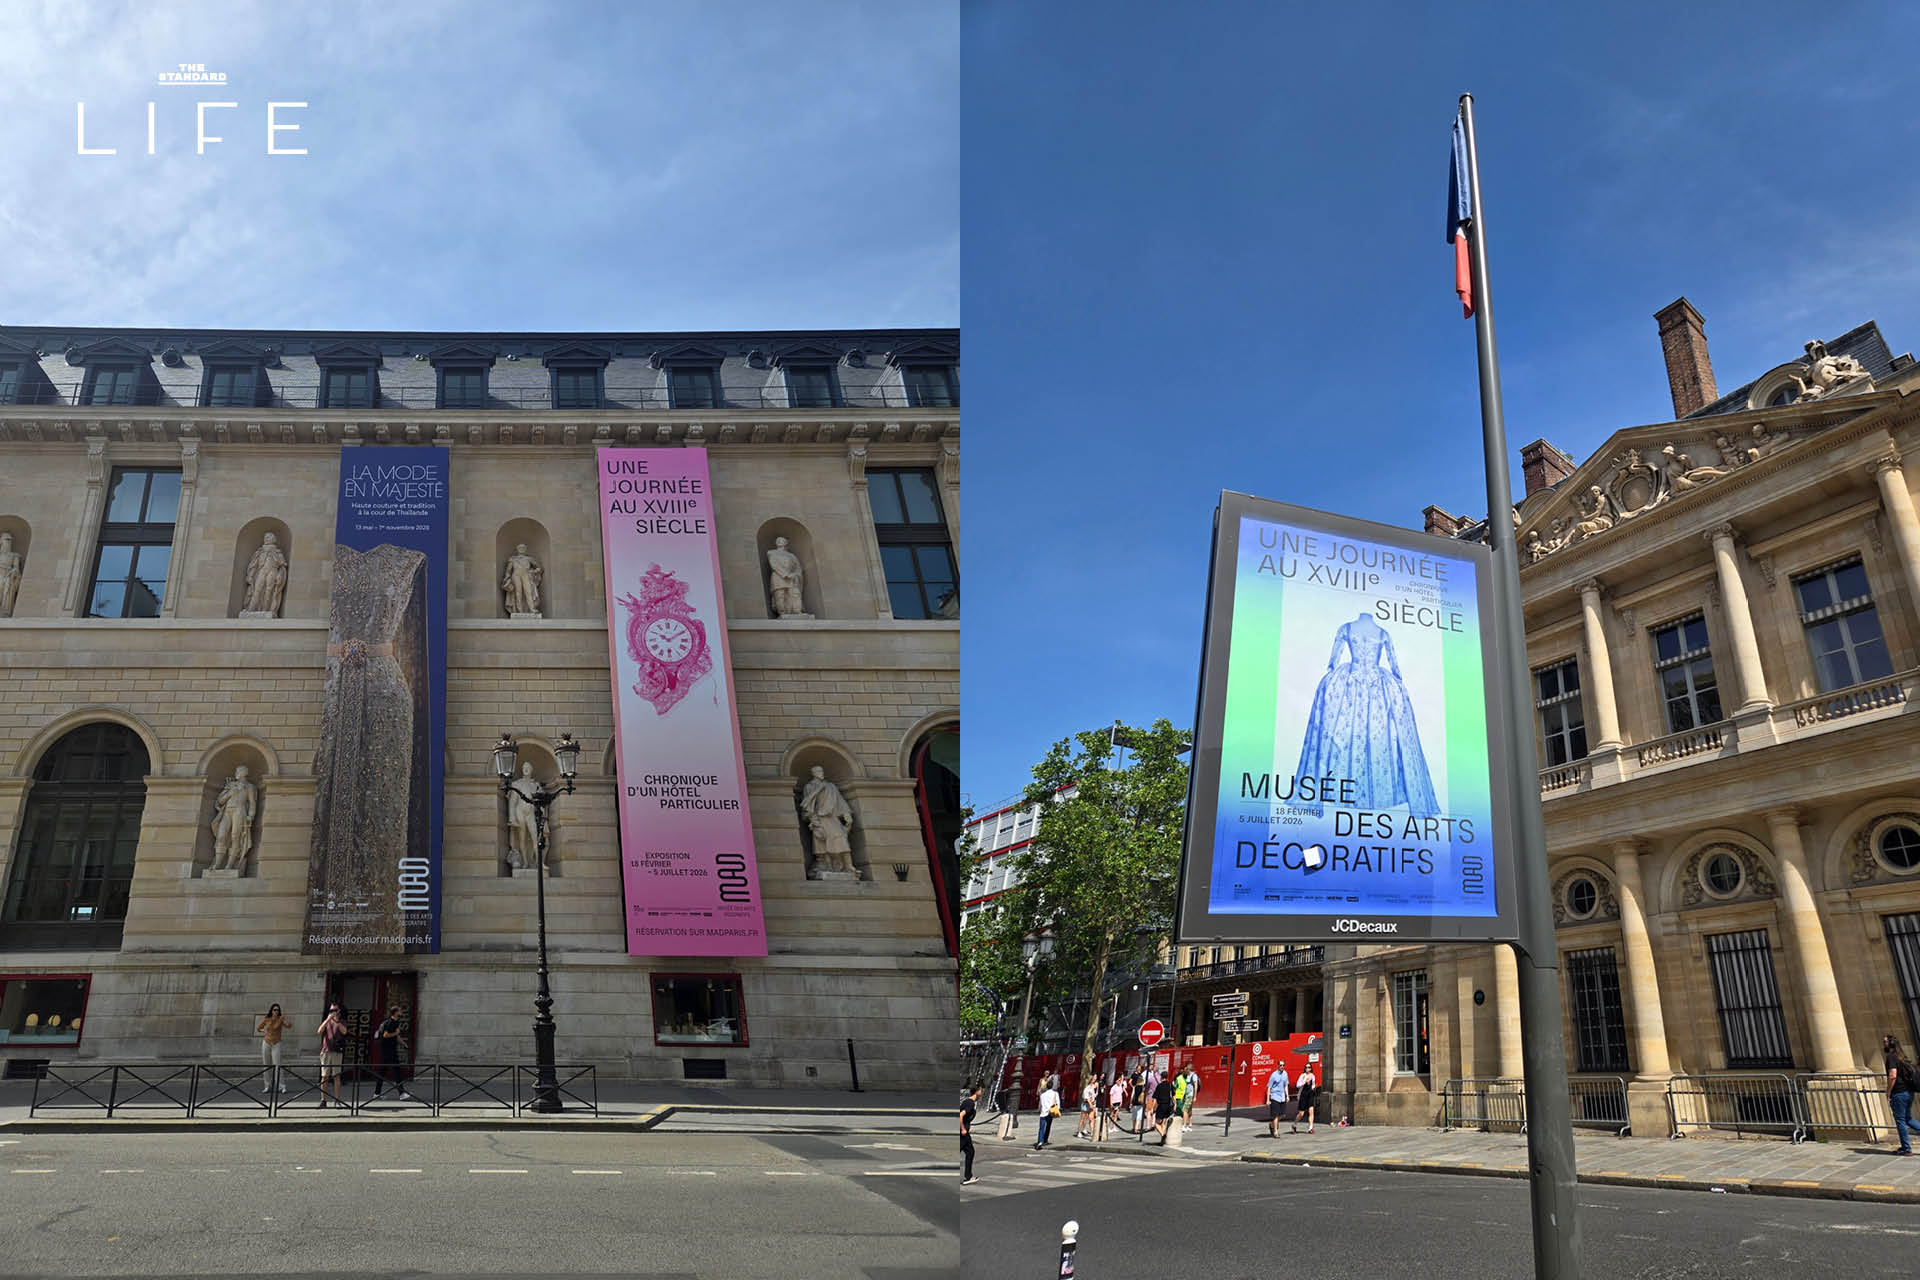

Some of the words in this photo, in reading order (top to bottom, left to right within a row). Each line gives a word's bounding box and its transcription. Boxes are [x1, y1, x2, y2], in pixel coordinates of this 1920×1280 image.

[352, 464, 381, 484] LA
[378, 465, 438, 480] MODE
[608, 460, 648, 474] UNE
[344, 478, 366, 498] EN
[372, 481, 444, 502] MAJESTÉ
[608, 476, 702, 494] JOURNÉE
[610, 500, 636, 514] AU
[643, 500, 696, 514] XVIIIe
[636, 516, 707, 534] SIÈCLE
[1259, 528, 1318, 558] UNE
[1326, 542, 1449, 582] JOURNÉE
[1258, 554, 1297, 578] AU
[1308, 562, 1380, 592] XVIIIe
[1376, 599, 1464, 632] SIÈCLE
[644, 774, 718, 786] CHRONIQUE
[628, 786, 658, 797] D'UN
[661, 784, 700, 798] HÔTEL
[1240, 771, 1356, 804] MUSÉE
[660, 799, 740, 810] PARTICULIER
[1287, 806, 1321, 816] FÉVRIER
[1246, 816, 1281, 824] JUILLET
[1282, 816, 1304, 825] 2026
[1335, 812, 1393, 839] DES
[1402, 816, 1475, 844] ARTS
[1236, 834, 1434, 874] DÉCORATIFS
[640, 860, 672, 868] FÉVRIER
[690, 928, 704, 936] SUR
[706, 928, 759, 937] MADPARIS.FR
[1332, 920, 1398, 933] JCDecaux
[308, 934, 363, 944] Réservation
[381, 934, 432, 946] madparis.fr
